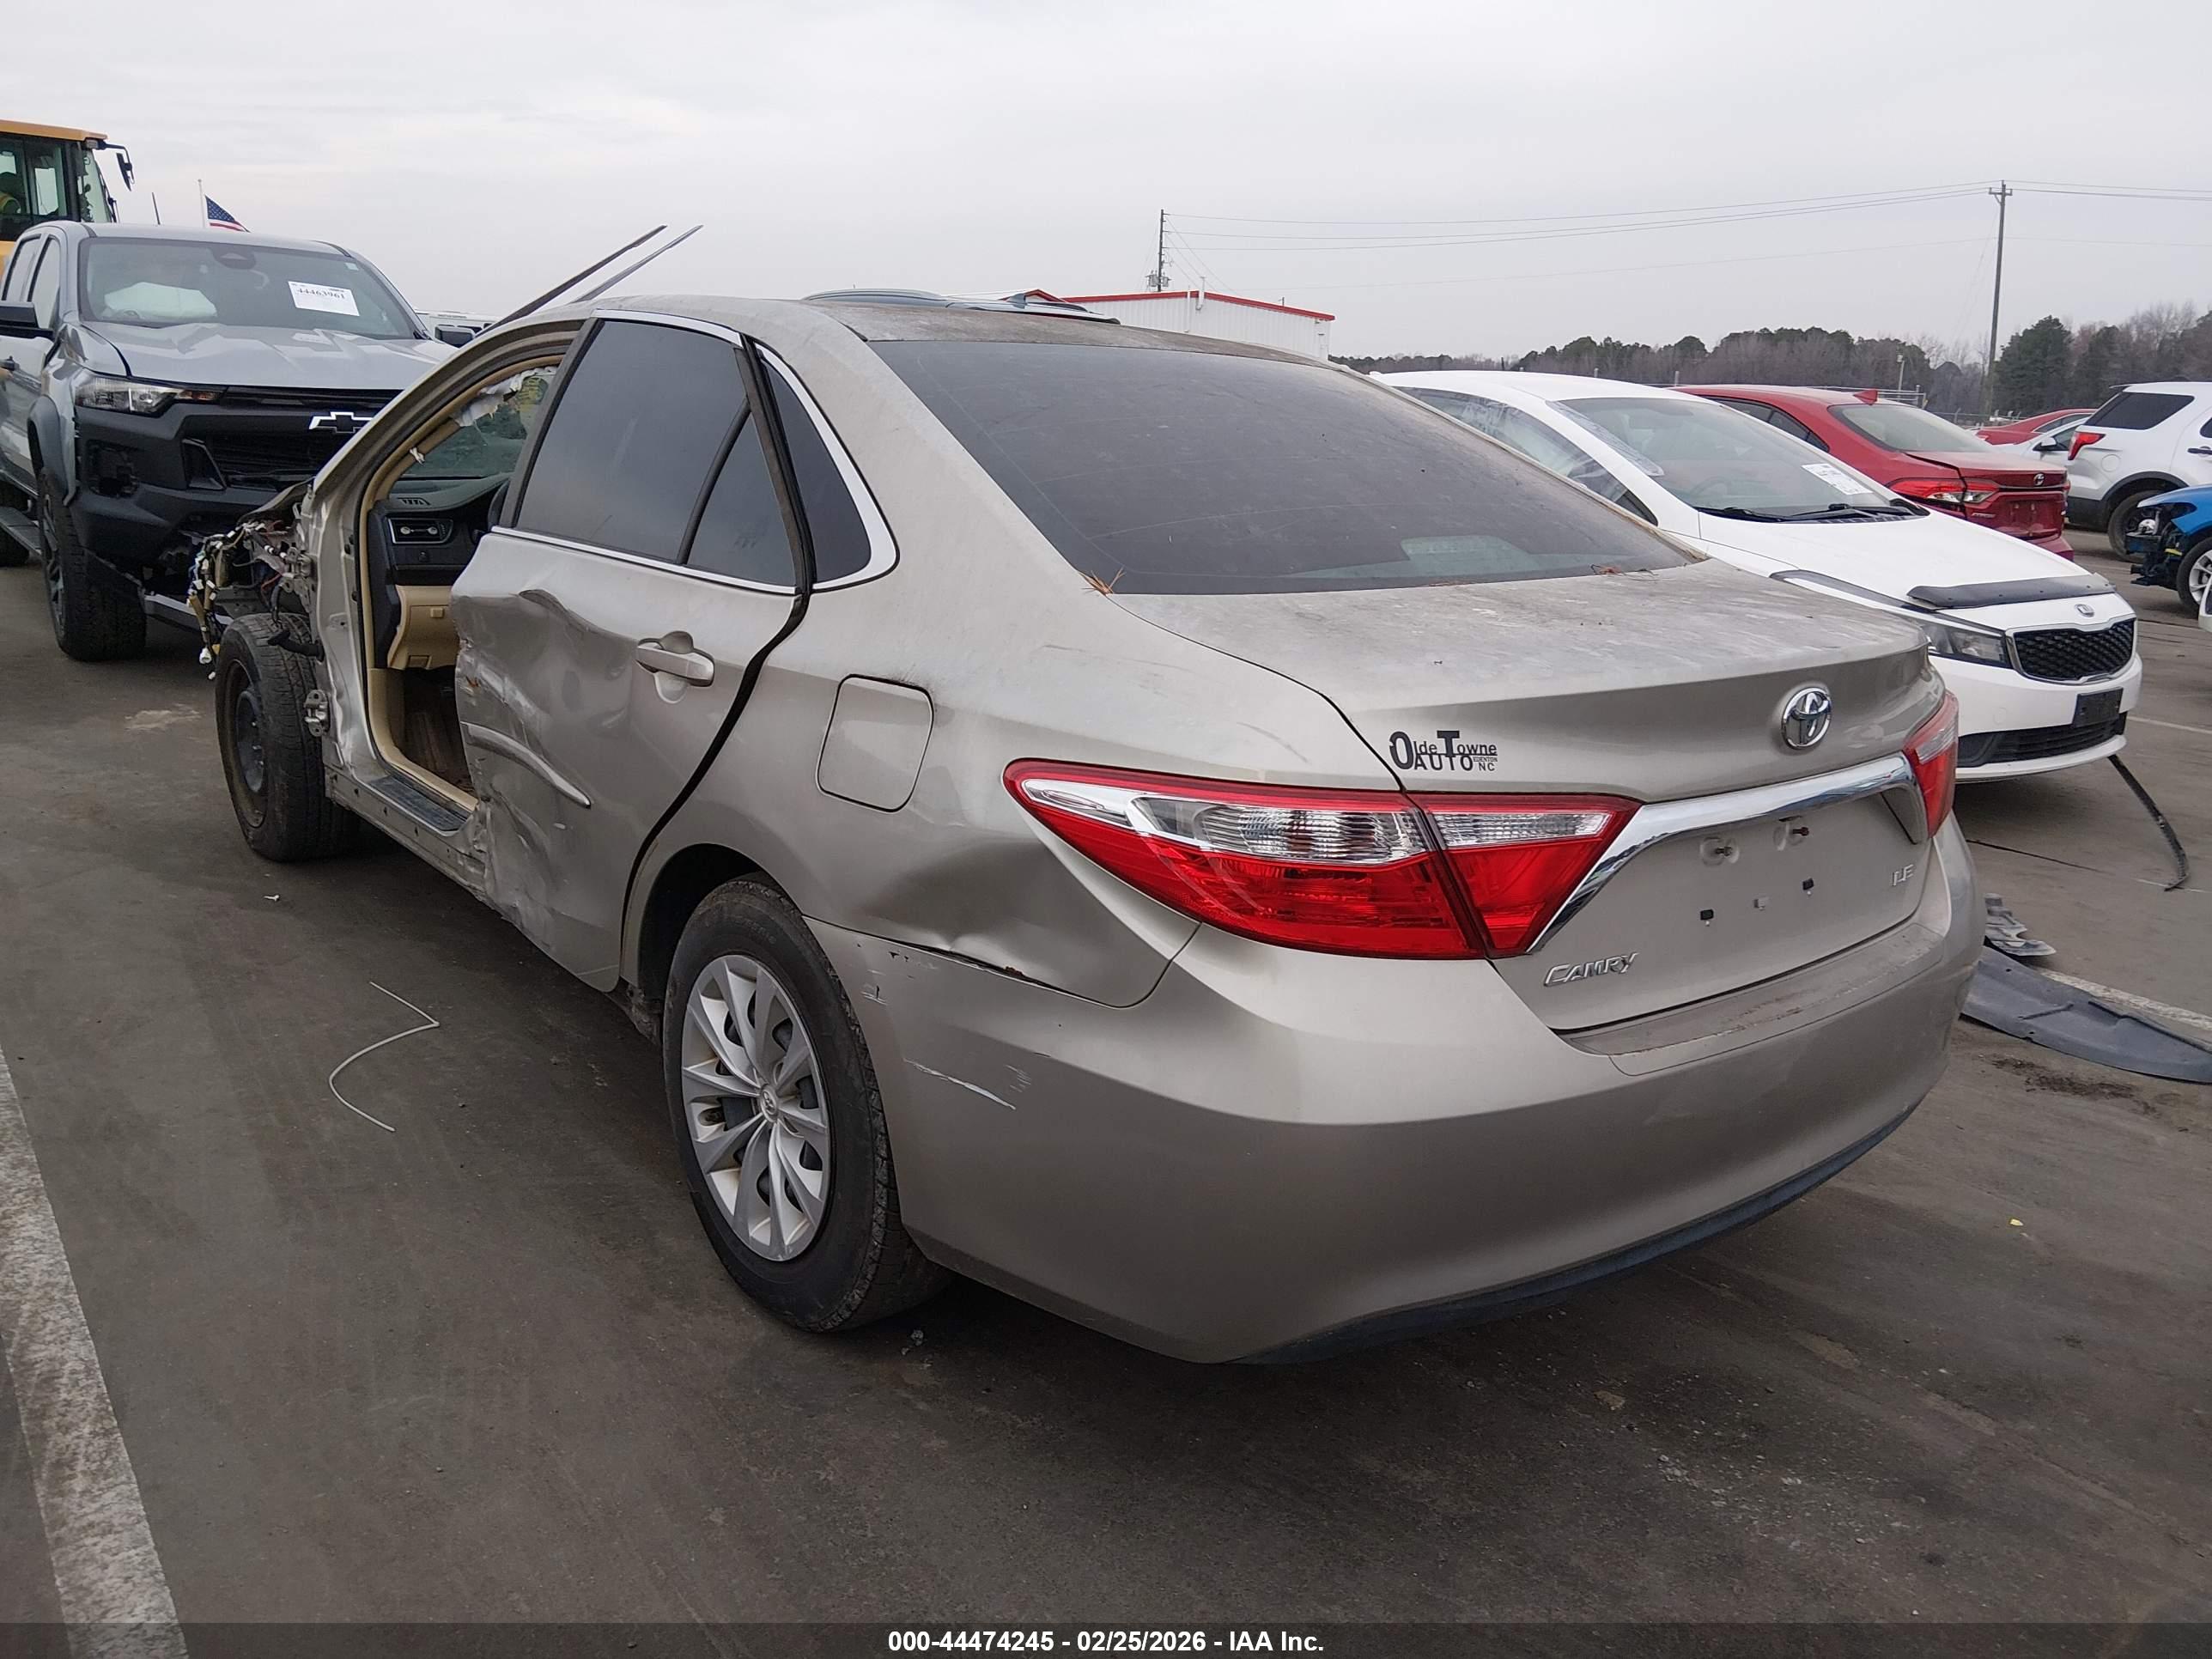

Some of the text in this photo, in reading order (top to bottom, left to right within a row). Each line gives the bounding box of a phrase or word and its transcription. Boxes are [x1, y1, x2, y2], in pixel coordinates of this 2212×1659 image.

[1389, 730, 1498, 770] Olde Towne
[1413, 755, 1474, 771] AUTO
[1478, 763, 1496, 772] NC
[1892, 863, 1915, 887] LE
[1544, 952, 1638, 988] CAMRY
